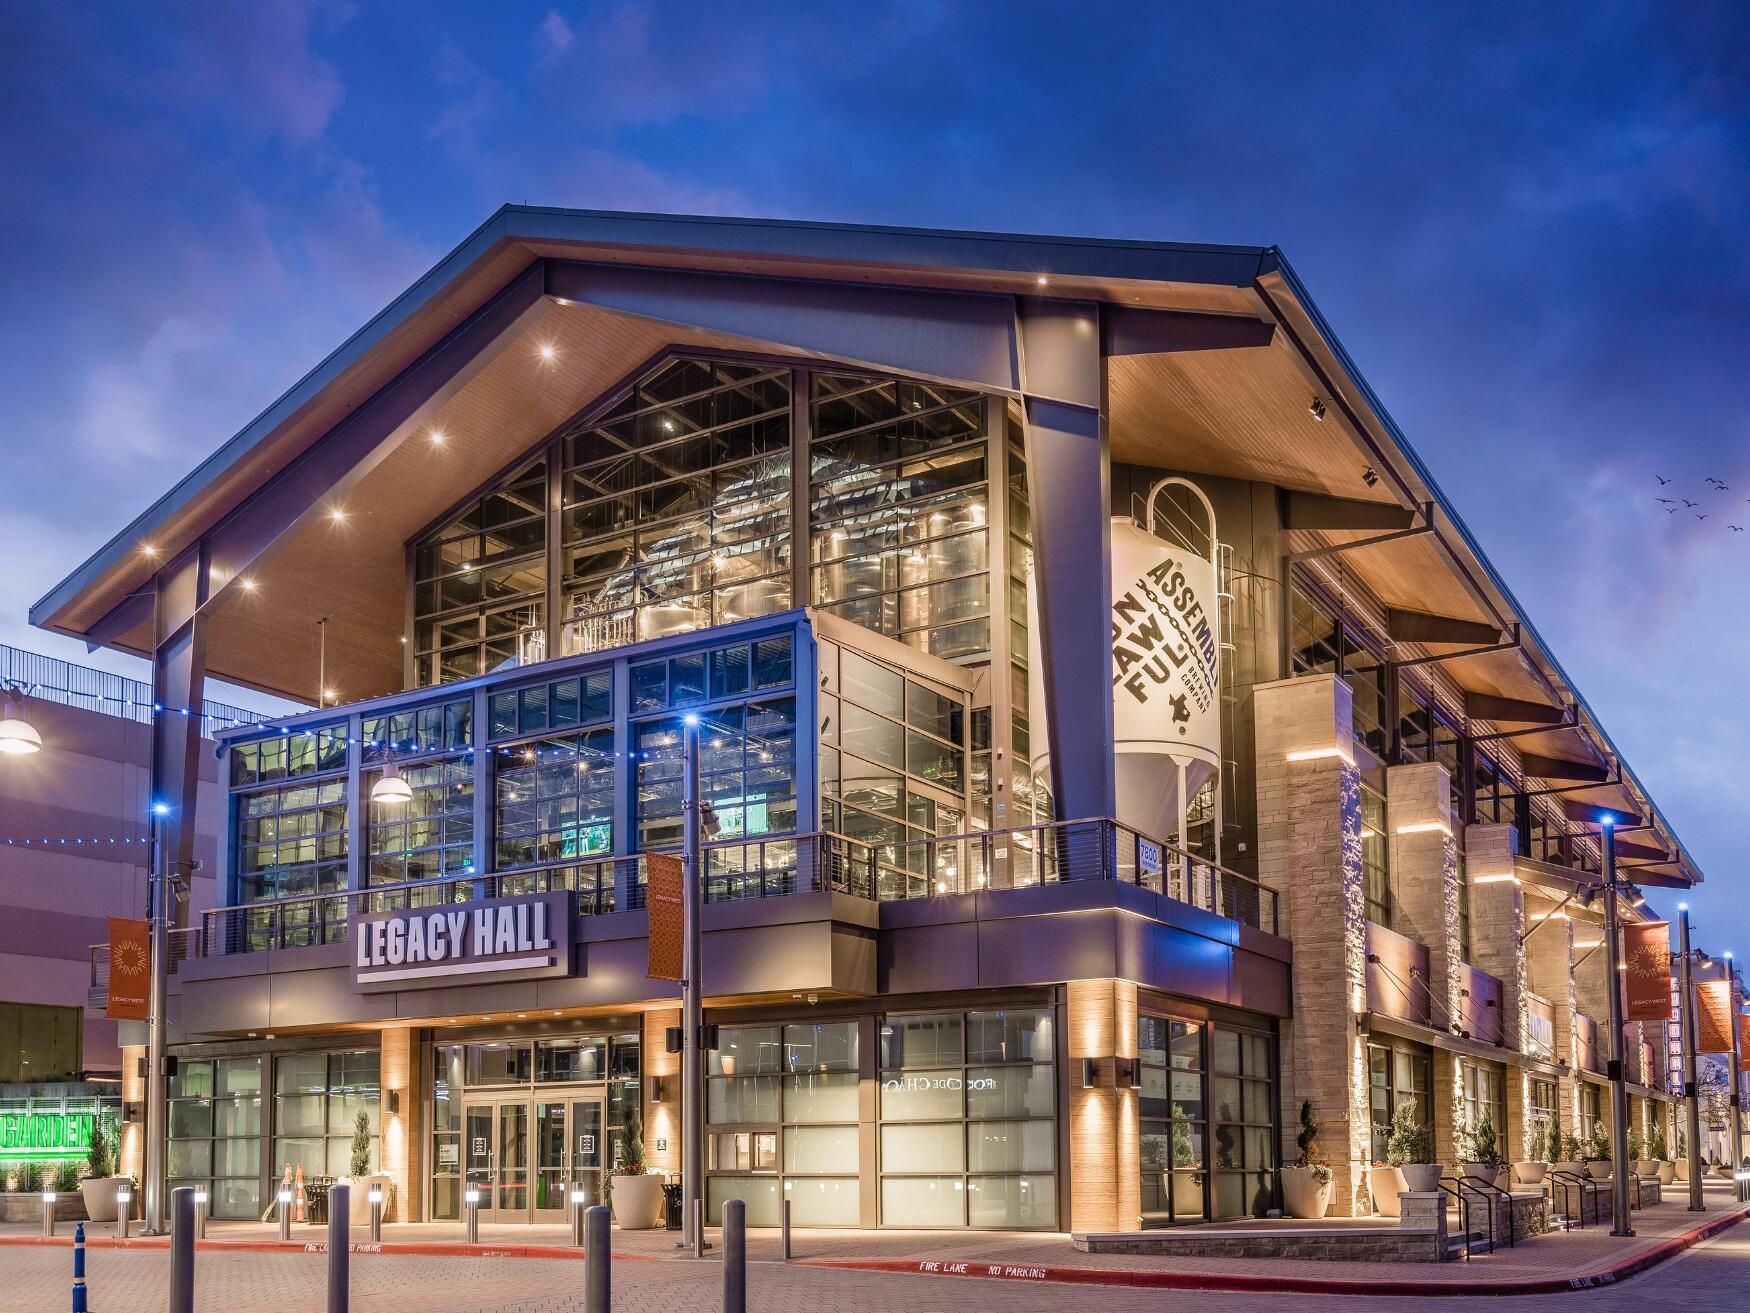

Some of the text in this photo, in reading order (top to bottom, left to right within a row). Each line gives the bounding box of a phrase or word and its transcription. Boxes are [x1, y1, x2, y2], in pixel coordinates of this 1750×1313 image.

[1123, 643, 1189, 704] FUL
[1180, 673, 1207, 714] COMPANY
[1187, 666, 1211, 708] BREWING
[1140, 844, 1158, 863] 7800
[357, 901, 550, 967] LEGACY HALL
[0, 1115, 94, 1147] GARDEN
[920, 1261, 1046, 1279] FIRE LANE NO PARKING
